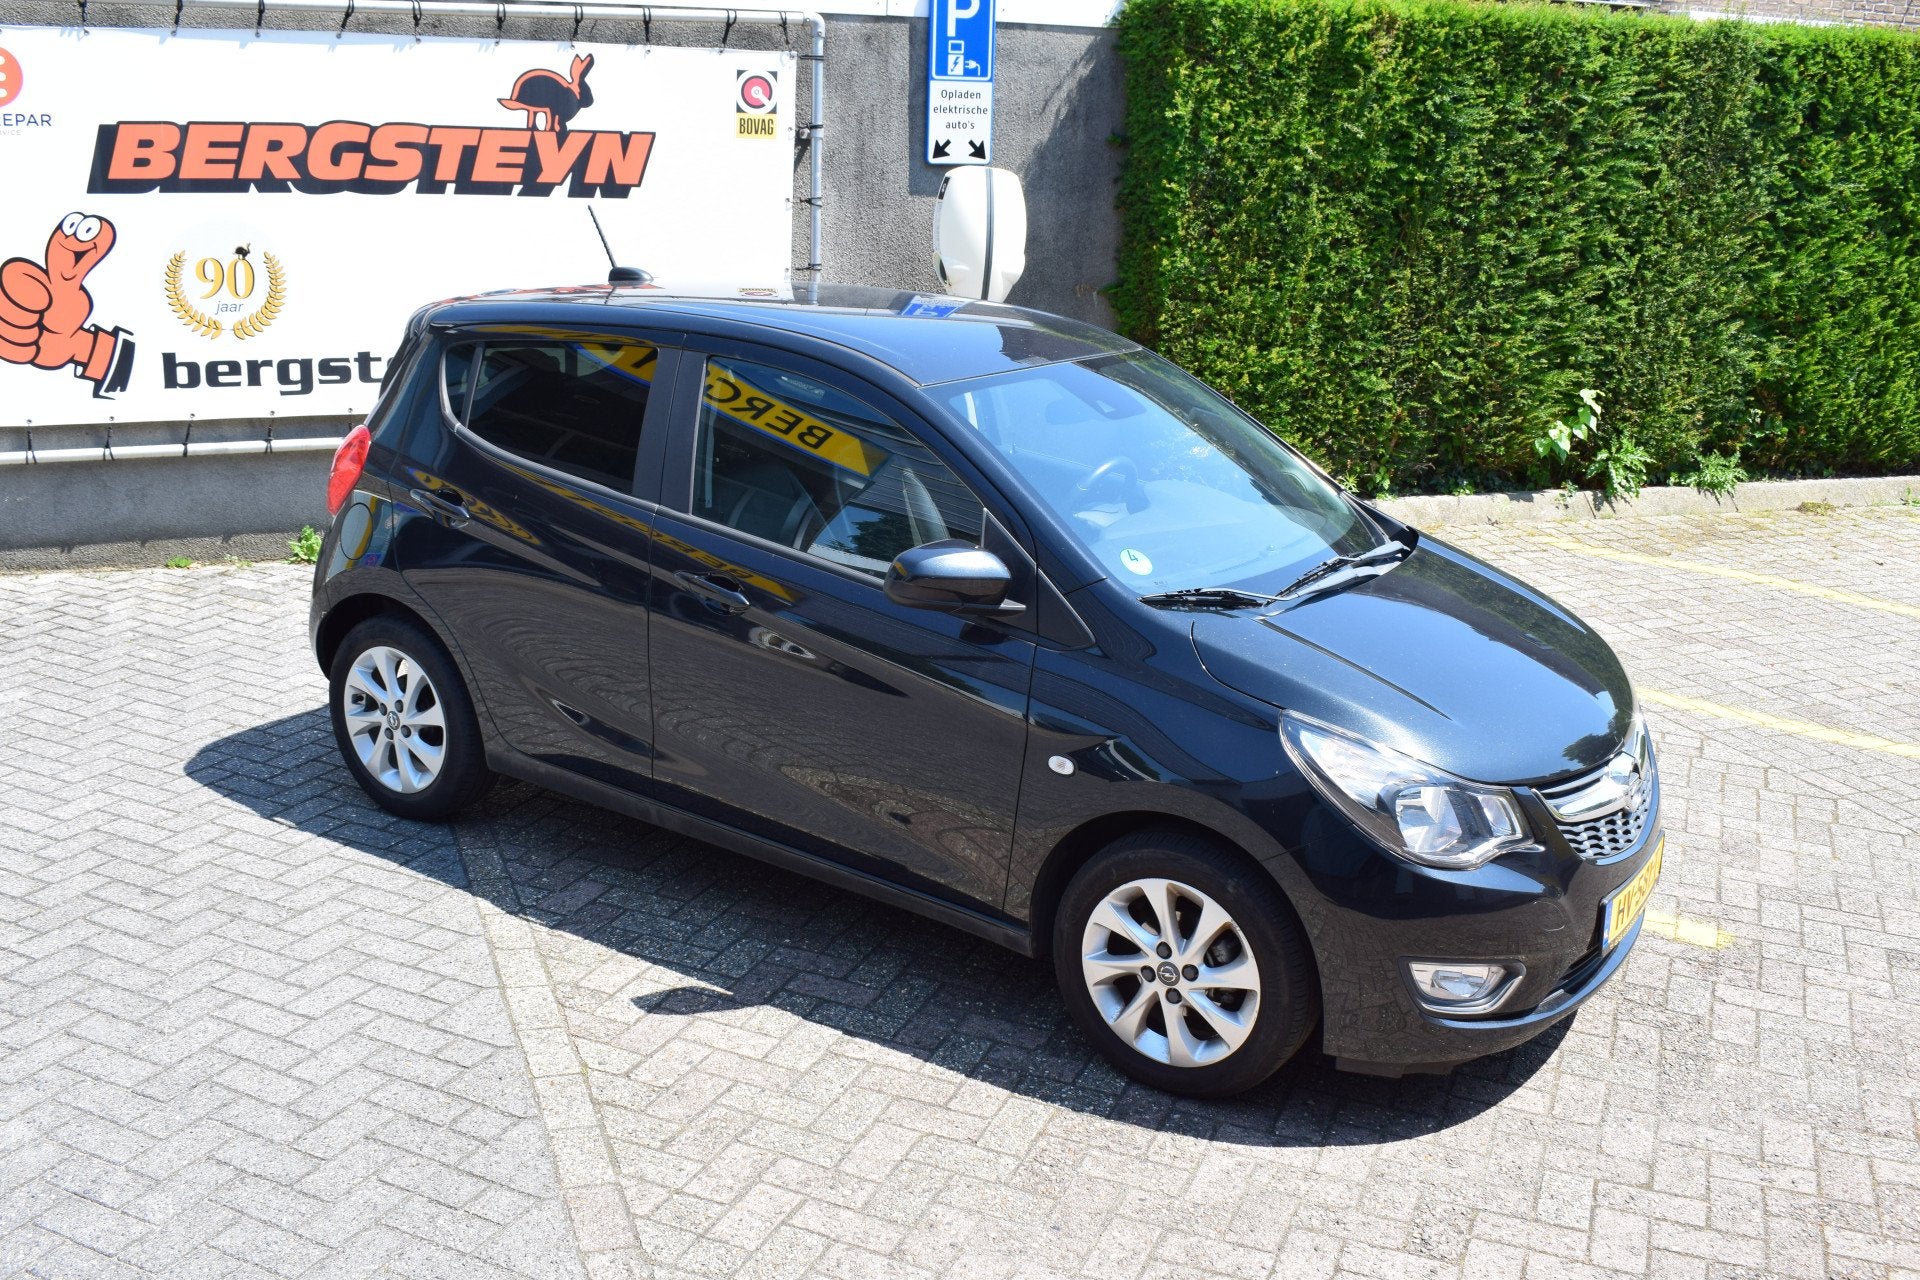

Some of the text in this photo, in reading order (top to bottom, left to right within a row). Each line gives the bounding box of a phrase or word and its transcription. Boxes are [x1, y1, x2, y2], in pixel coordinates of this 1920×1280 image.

[947, 0, 980, 37] P
[940, 89, 981, 100] Opladen
[933, 104, 988, 115] elektrische
[0, 113, 52, 127] EPAR
[739, 117, 774, 136] BOVAG
[945, 120, 975, 130] auto's
[87, 120, 656, 199] BERGSTEYN
[195, 257, 255, 299] 90
[214, 300, 244, 315] jaar
[161, 351, 396, 396] bergst
